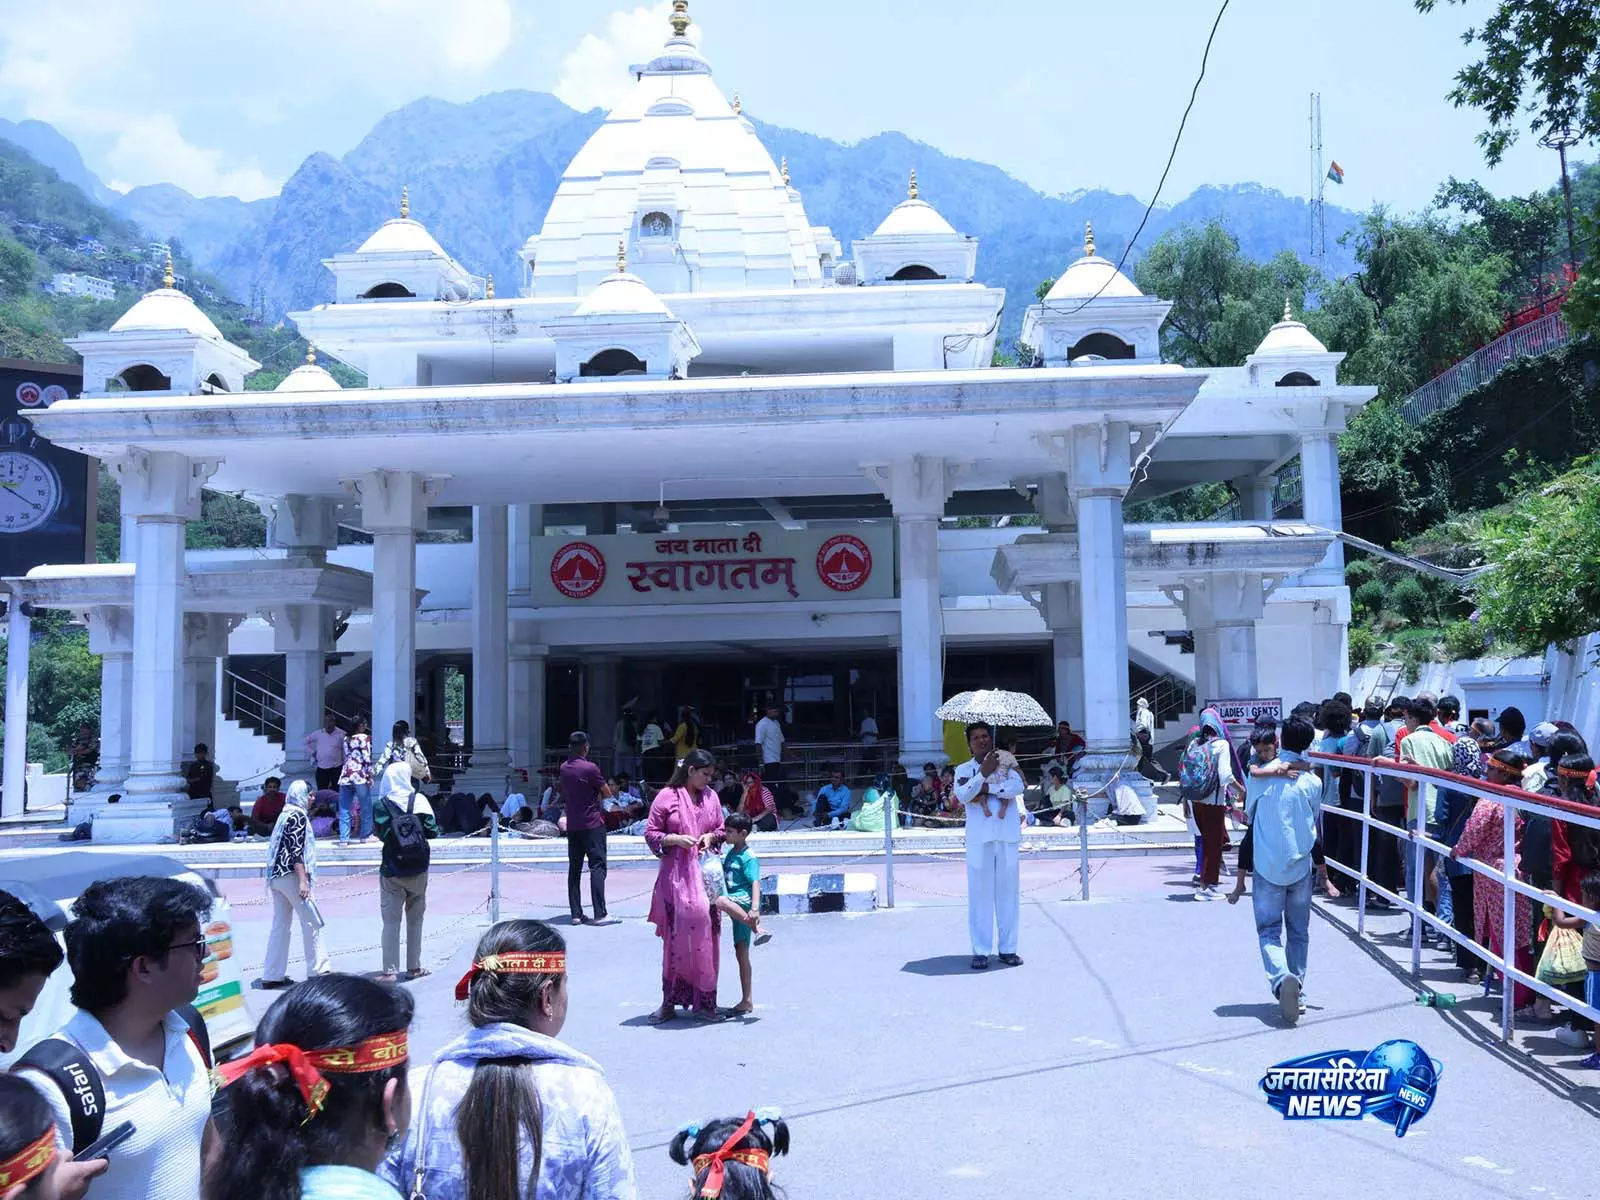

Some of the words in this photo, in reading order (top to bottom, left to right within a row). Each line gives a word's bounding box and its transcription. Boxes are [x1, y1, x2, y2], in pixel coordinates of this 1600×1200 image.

[655, 539, 690, 554] जय
[693, 538, 739, 554] माता
[742, 530, 762, 553] दी
[626, 556, 800, 598] स्वागतम्
[1220, 707, 1245, 718] LADIES
[1251, 706, 1279, 717] GENTS
[532, 958, 546, 968] दी
[320, 1048, 357, 1065] से
[63, 1063, 98, 1116] safari
